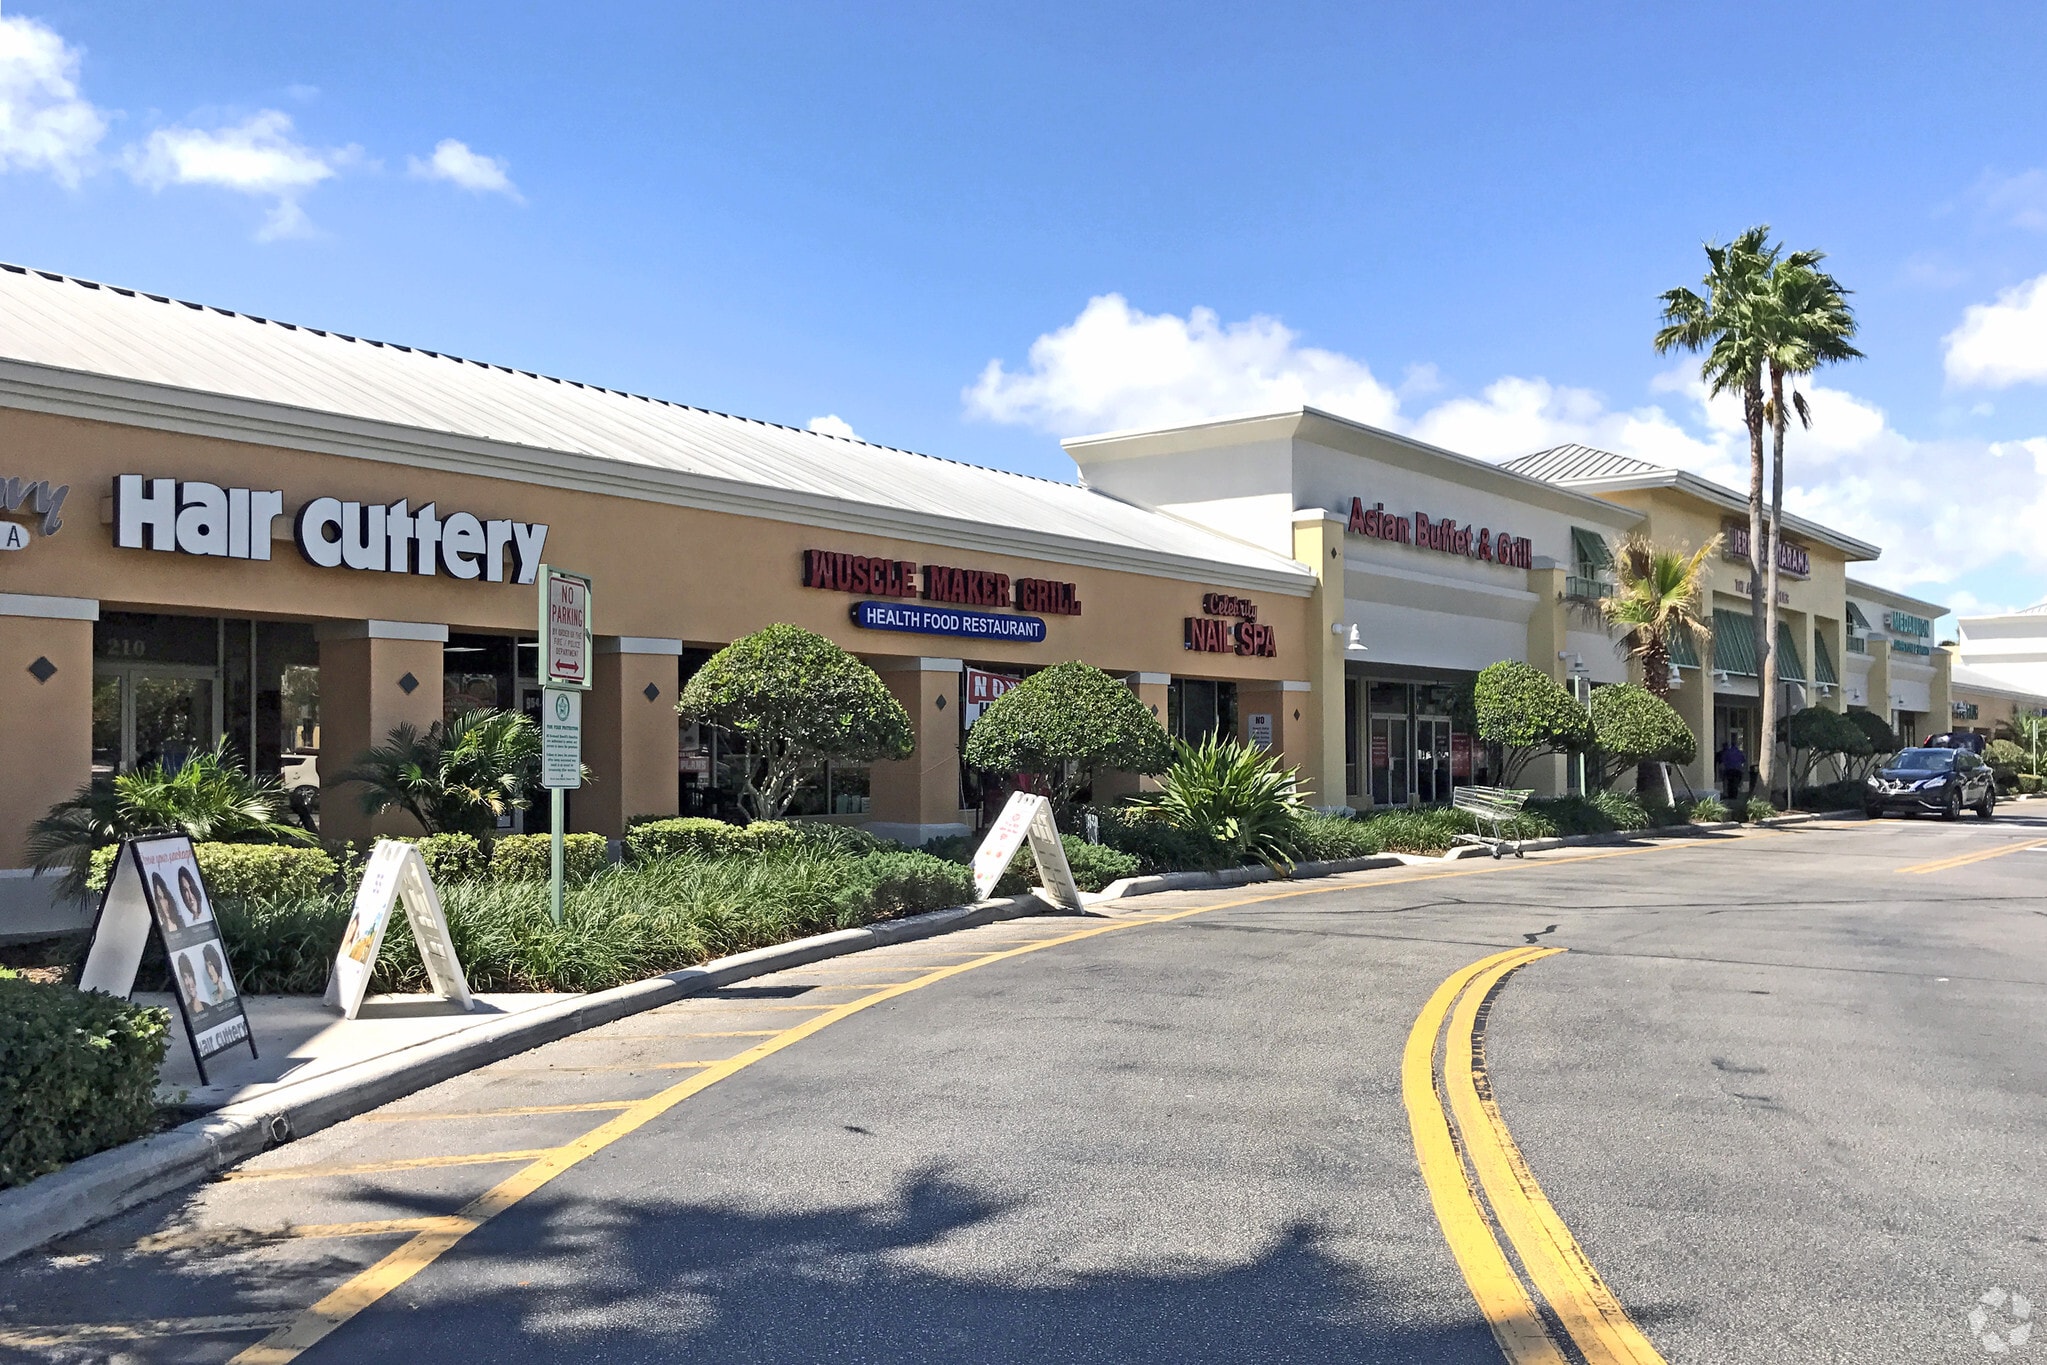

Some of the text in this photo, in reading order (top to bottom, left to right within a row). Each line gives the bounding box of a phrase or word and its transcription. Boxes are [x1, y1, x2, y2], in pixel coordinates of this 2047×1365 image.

[114, 474, 549, 584] Hair cuttery
[1348, 496, 1532, 570] Asian Buffet & Grill
[561, 585, 574, 604] NO
[803, 550, 1082, 615] MUSCLE MAKER GRILL
[552, 604, 582, 628] PARKING
[866, 607, 1040, 637] HEALTH FOOD RESTAURANT
[1203, 593, 1258, 623] Celebrity
[107, 638, 145, 657] 210
[1184, 617, 1277, 657] NAIL SPA
[1255, 716, 1265, 724] NO
